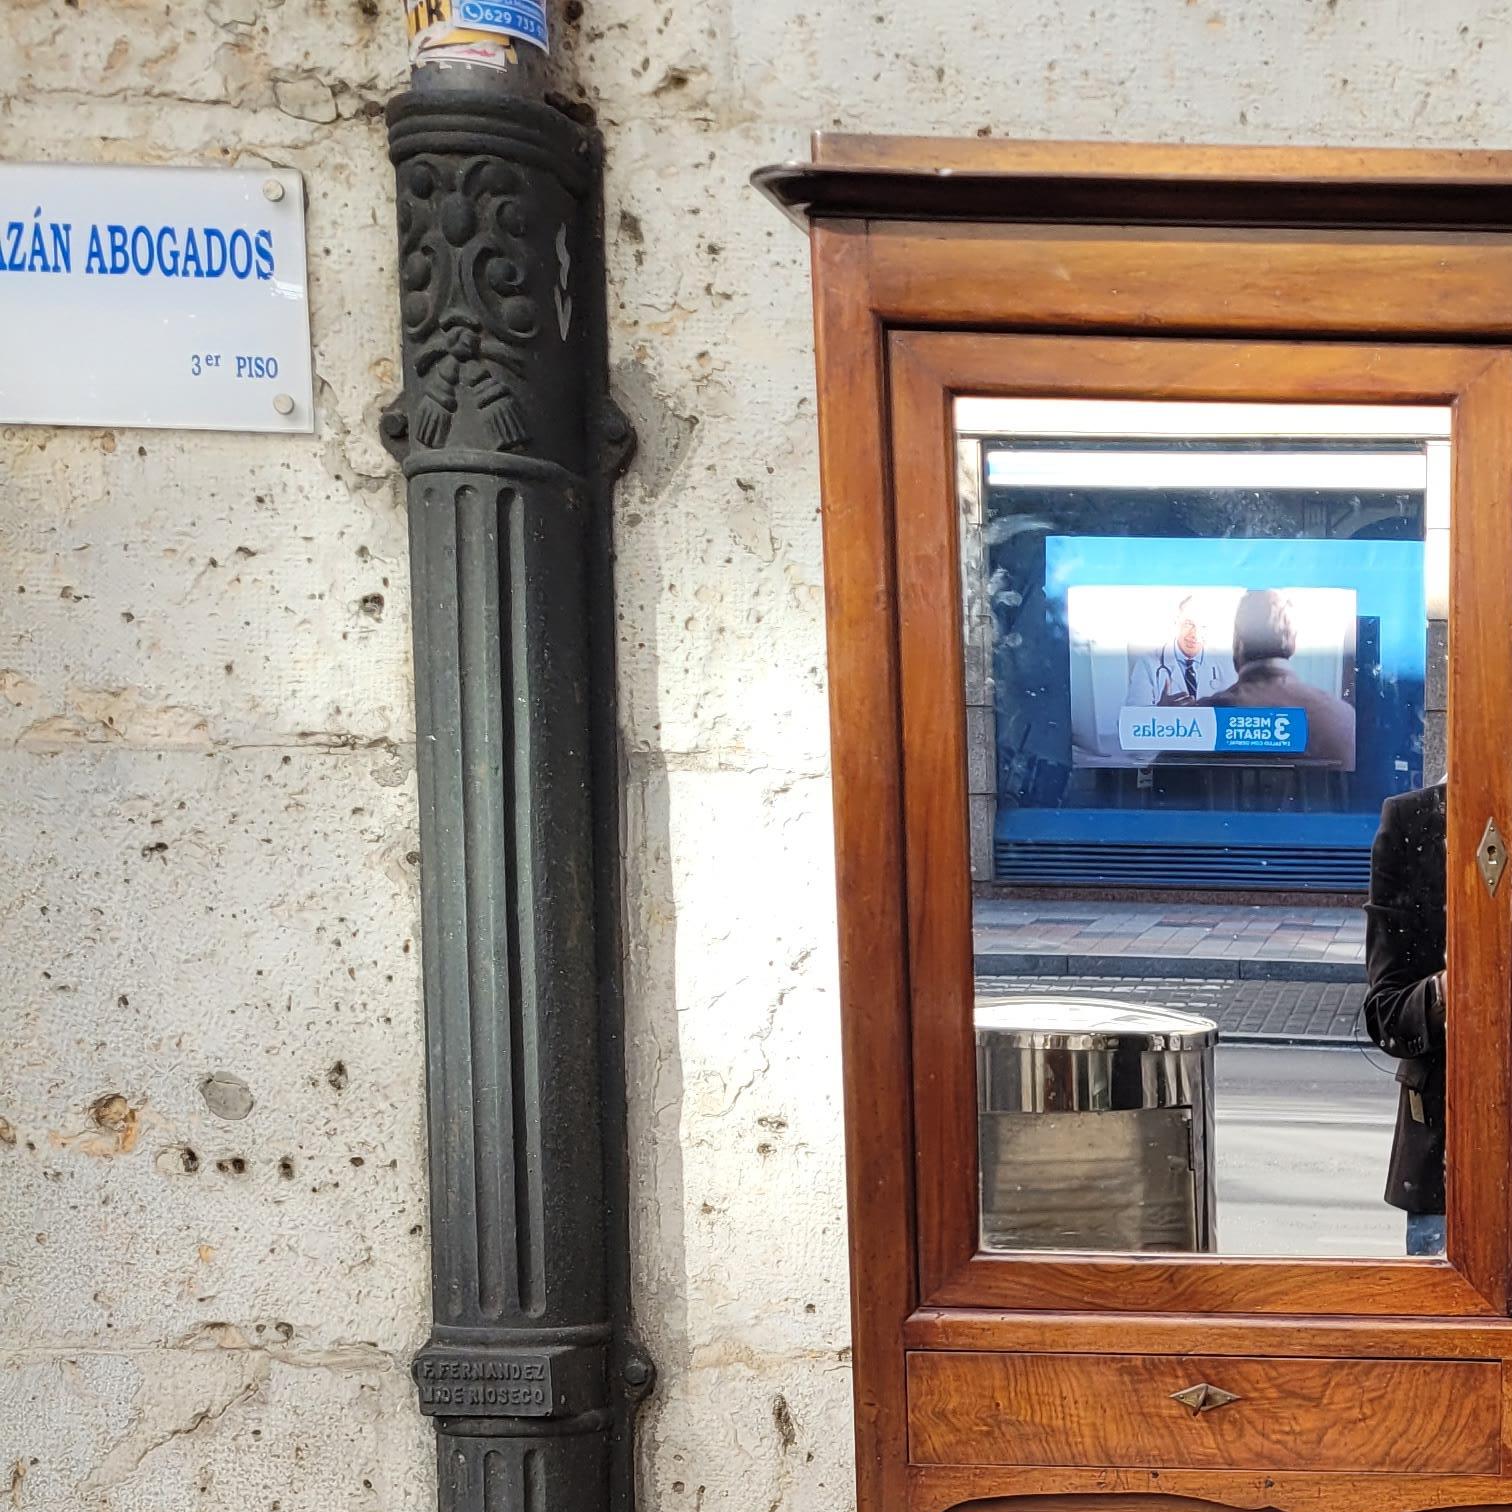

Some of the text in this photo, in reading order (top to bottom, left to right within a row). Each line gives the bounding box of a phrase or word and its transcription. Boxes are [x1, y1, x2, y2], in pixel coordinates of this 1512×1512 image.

[484, 9, 512, 24] 629
[85, 223, 275, 281] ABOGADOS
[236, 355, 279, 379] PISO
[469, 1386, 545, 1405] RIOSECO
